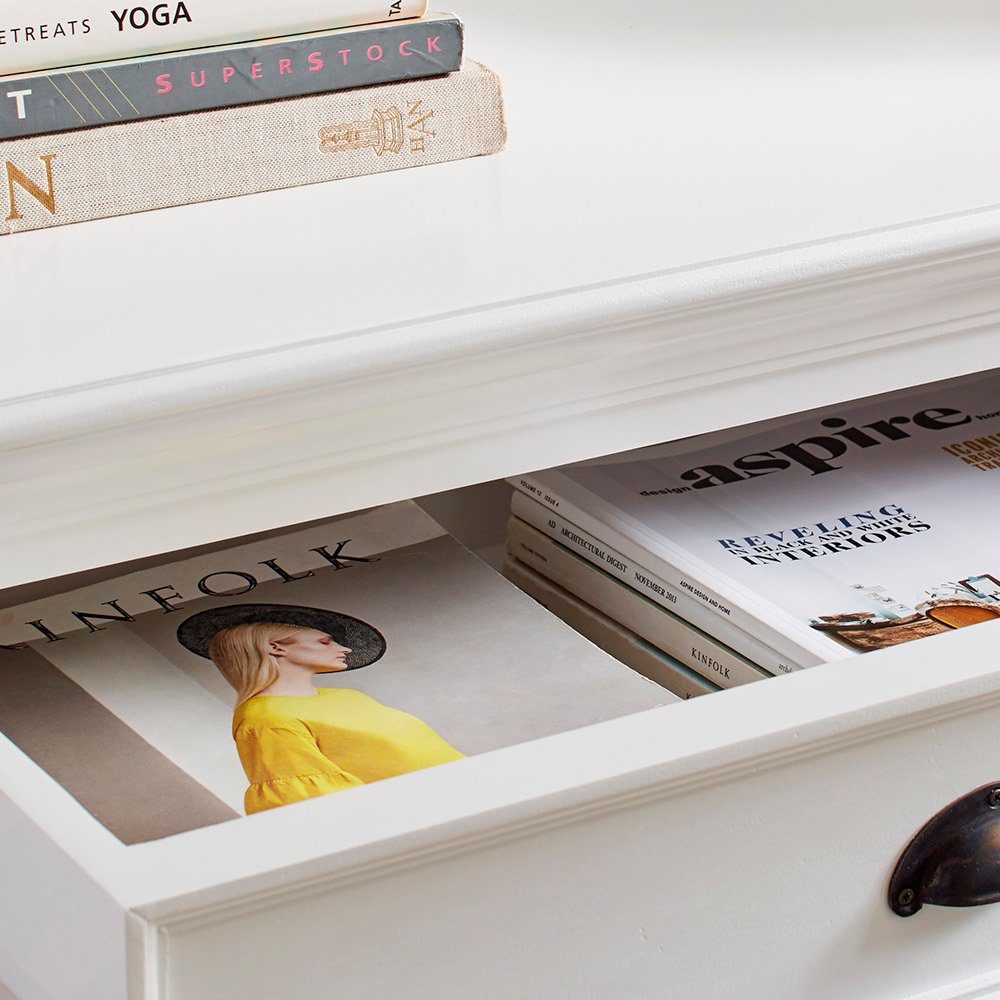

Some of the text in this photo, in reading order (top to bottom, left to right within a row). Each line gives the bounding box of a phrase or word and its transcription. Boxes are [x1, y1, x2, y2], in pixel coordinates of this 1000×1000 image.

[110, 1, 193, 32] YOGA
[155, 36, 442, 95] SUPERSTOCK
[6, 89, 33, 120] T
[639, 485, 692, 497] design
[680, 407, 973, 490] aspire
[520, 479, 537, 493] VOLUME
[717, 503, 905, 549] REVELING
[728, 513, 917, 556] IN BLACK AND WHITE
[738, 520, 932, 566] INTERIORS
[547, 519, 556, 529] AD
[561, 528, 606, 561] ARCHITECTURAL
[606, 554, 628, 573] DIGEST
[634, 572, 666, 597] NOVEMBER
[0, 538, 382, 650] INFOLK
[680, 580, 731, 616] ASPIRE DESIGN AND HOME
[691, 646, 731, 680] KINFOLK
